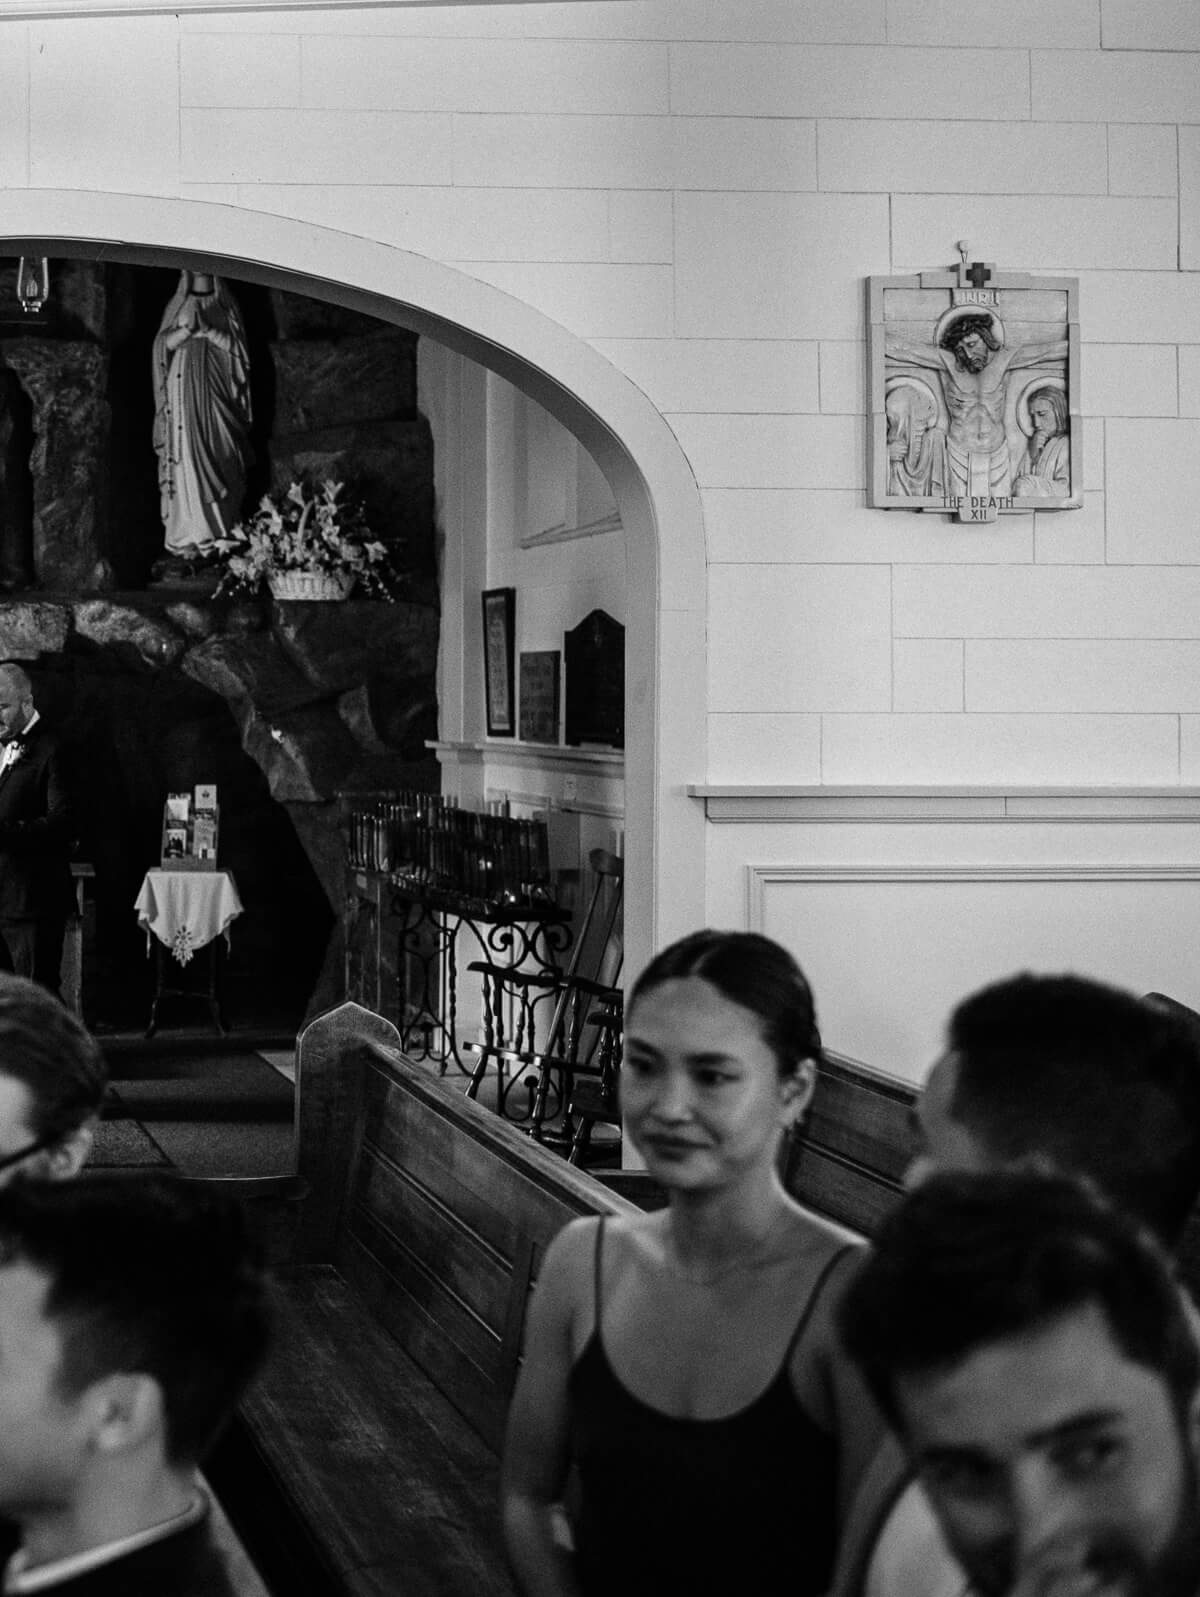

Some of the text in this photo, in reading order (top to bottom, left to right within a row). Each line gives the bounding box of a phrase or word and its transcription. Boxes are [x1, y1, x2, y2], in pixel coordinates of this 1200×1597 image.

[941, 496, 1014, 509] THE DEATH
[971, 509, 987, 521] XII
